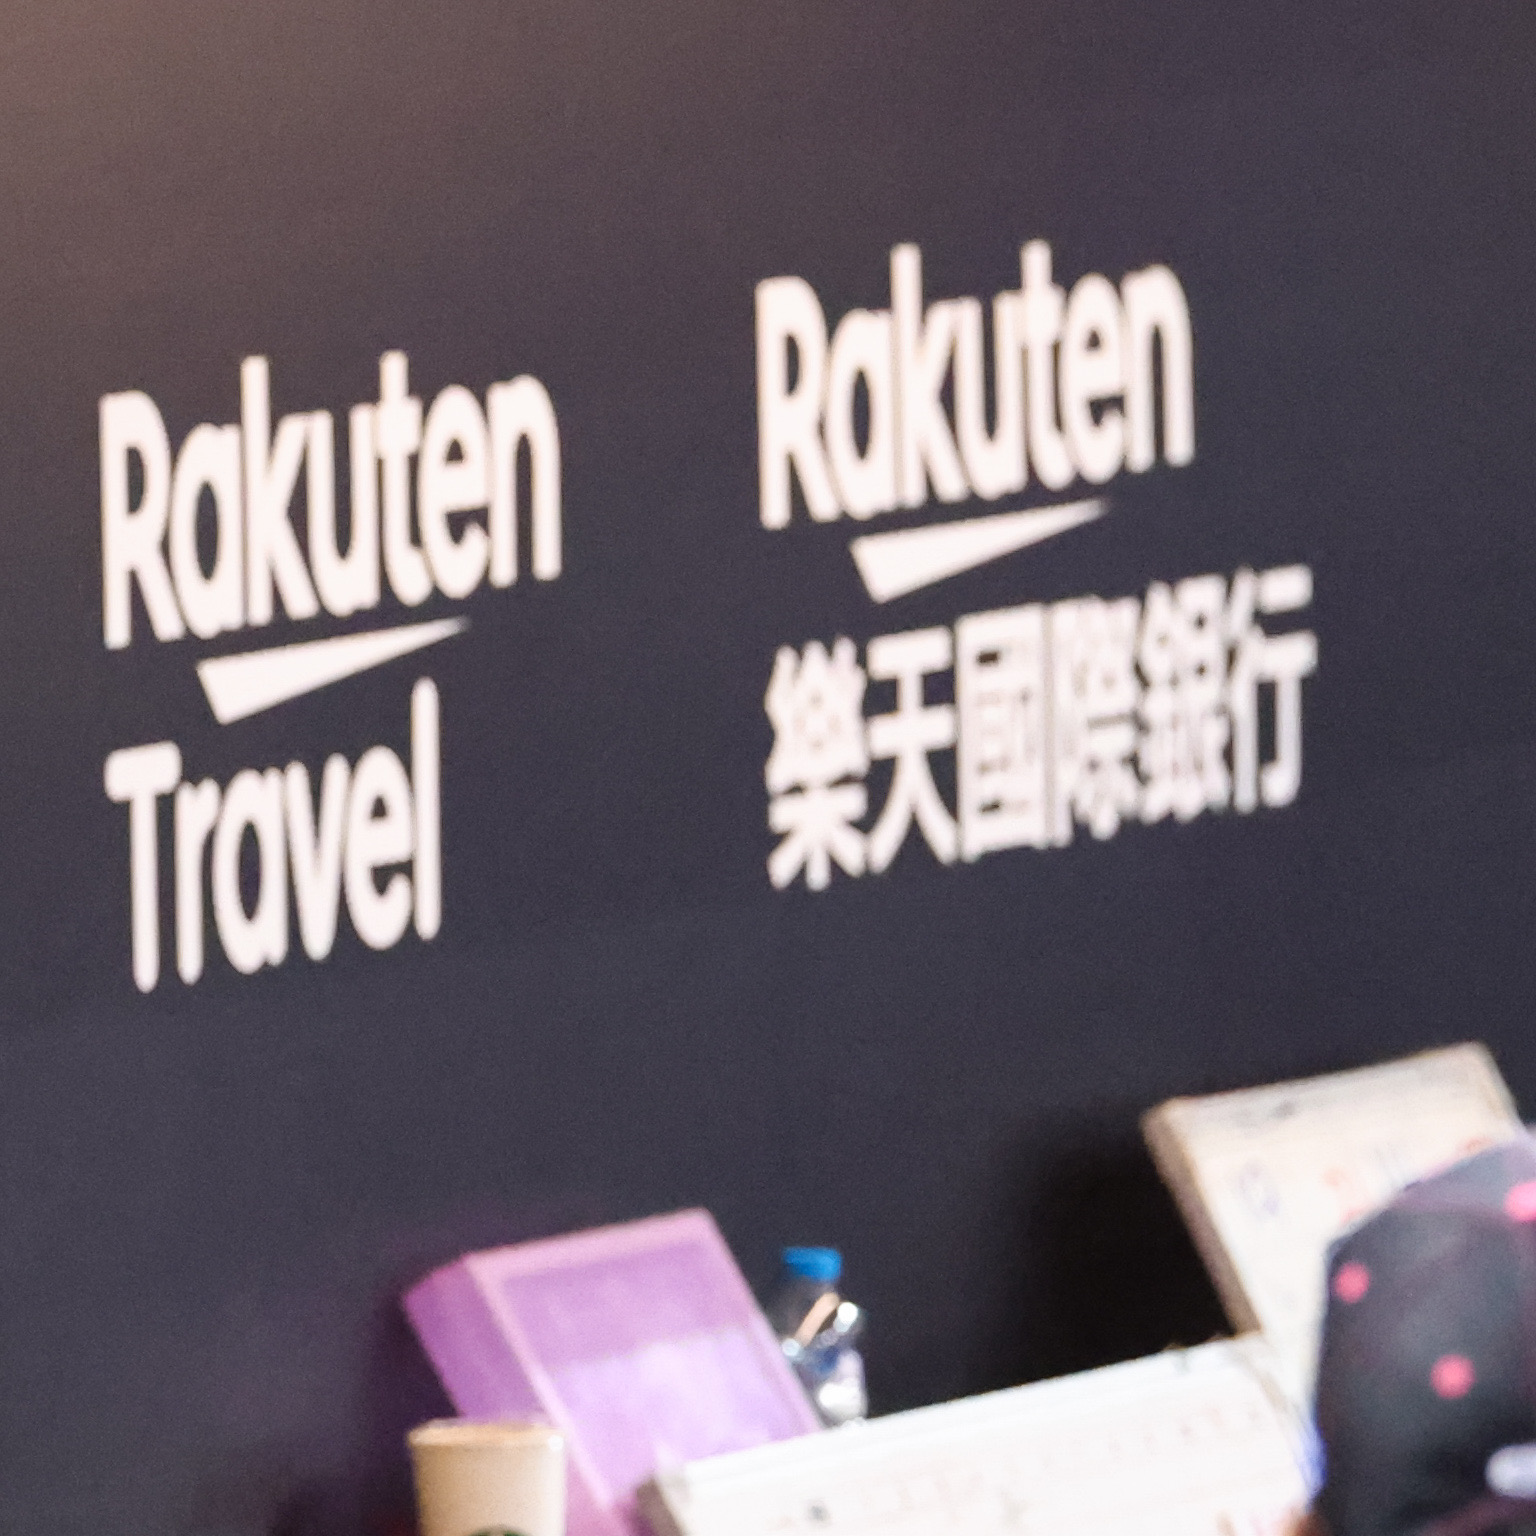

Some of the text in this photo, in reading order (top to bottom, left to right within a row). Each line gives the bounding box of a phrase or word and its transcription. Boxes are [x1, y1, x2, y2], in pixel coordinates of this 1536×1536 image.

[99, 350, 563, 650] Rakuten
[755, 239, 1195, 530] Rakuten
[104, 676, 443, 994] Travel
[764, 565, 1318, 891] 樂天國際銀行
